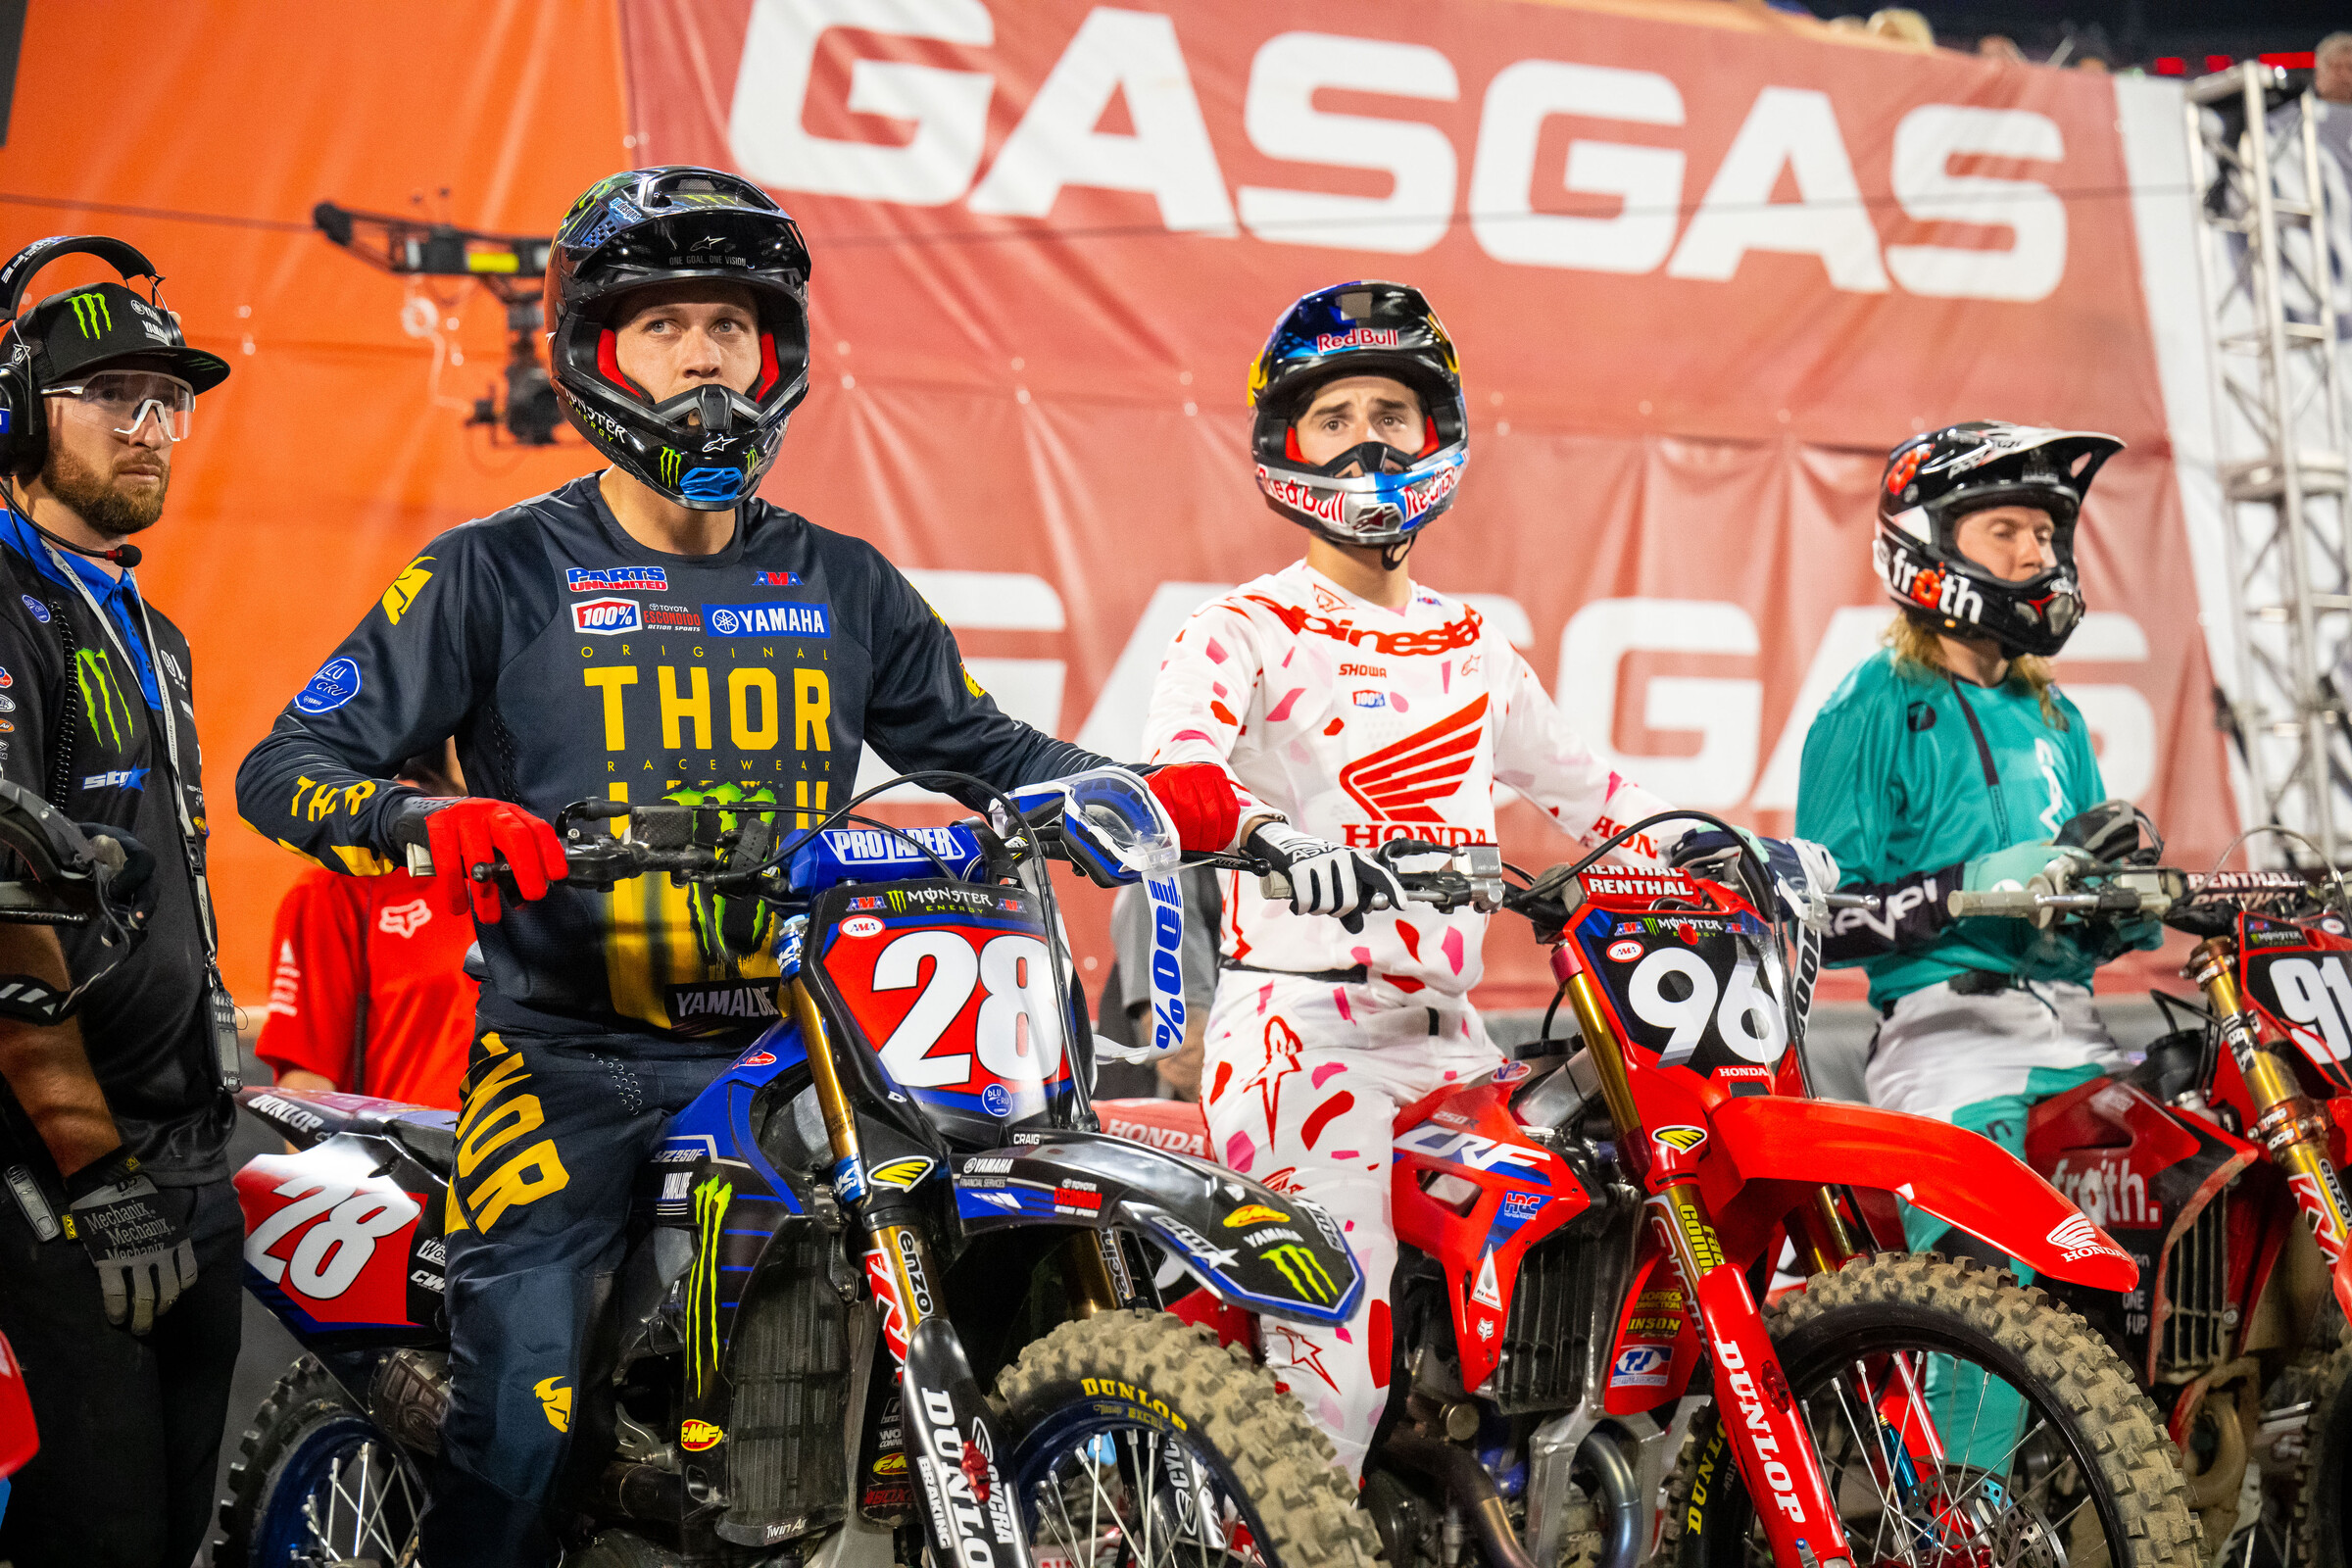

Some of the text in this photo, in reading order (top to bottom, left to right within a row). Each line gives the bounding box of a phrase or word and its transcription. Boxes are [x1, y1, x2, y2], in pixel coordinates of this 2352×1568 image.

[728, 0, 2068, 301] GASGAS
[669, 256, 747, 266] ONE GOAL. ONE VISION
[1317, 329, 1397, 352] Red Bull
[1258, 465, 1346, 524] Red Bull
[565, 566, 668, 582] PARTS
[752, 571, 805, 586] AMA
[569, 580, 668, 592] UNLIMITED
[1892, 548, 1984, 624] froth
[582, 605, 634, 626] 100%
[643, 611, 701, 627] ESCONDIDO
[660, 605, 689, 613] TOYOTA
[739, 609, 825, 633] YAMAHA
[324, 664, 347, 680] LU
[1339, 663, 1388, 678] SHOWA
[849, 566, 2155, 813] GGS
[1354, 692, 1385, 707] 100%
[584, 665, 831, 752] THOR
[608, 760, 830, 772] RACEWEAR
[834, 827, 955, 860] PROTAPER
[1342, 824, 1488, 849] HONDA
[1592, 816, 1658, 860] HON
[1588, 878, 1693, 896] RENTHAL
[846, 887, 1027, 912] AMA MONSTER AMA
[926, 905, 984, 913] ENERGY
[850, 922, 876, 932] AMA
[1614, 921, 1646, 937] AMA
[1657, 916, 1724, 932] MONSTER
[1616, 946, 1638, 956] AMA
[1149, 875, 1185, 1050] 100%
[1795, 929, 1820, 1033] 100
[872, 930, 1063, 1088] 28
[1628, 947, 1788, 1069] 96
[1719, 1067, 1769, 1077] HONDA
[247, 1094, 324, 1133] DUNLOP
[1433, 1110, 1480, 1130] 250R
[1013, 1133, 1041, 1145] CRAIG
[1106, 1119, 1206, 1157] HONDA
[1393, 1124, 1551, 1171] CRF
[650, 1149, 707, 1163] YZ250F
[974, 1158, 1014, 1174] YAMAHA
[959, 1177, 1006, 1189] FINANCIAL SERVICES
[2319, 1157, 2352, 1220] enzo
[1505, 1193, 1542, 1216] HRC
[83, 1201, 150, 1235] Mechanix
[105, 1217, 171, 1247] Mechanix
[244, 1175, 422, 1300] 28
[1243, 1228, 1304, 1249] YAMAHA
[2061, 1245, 2130, 1263] HONDA
[897, 1230, 934, 1316] enzo
[1627, 1318, 1682, 1332] INSON
[1081, 1377, 1188, 1432] DUNLOP
[682, 1422, 719, 1443] FMF
[1715, 1340, 1806, 1523] DUNLOP
[873, 1454, 908, 1476] FM
[1687, 1417, 1728, 1536] DUNLO
[917, 1457, 953, 1549] BRAKING
[766, 1518, 808, 1539] Twin Air
